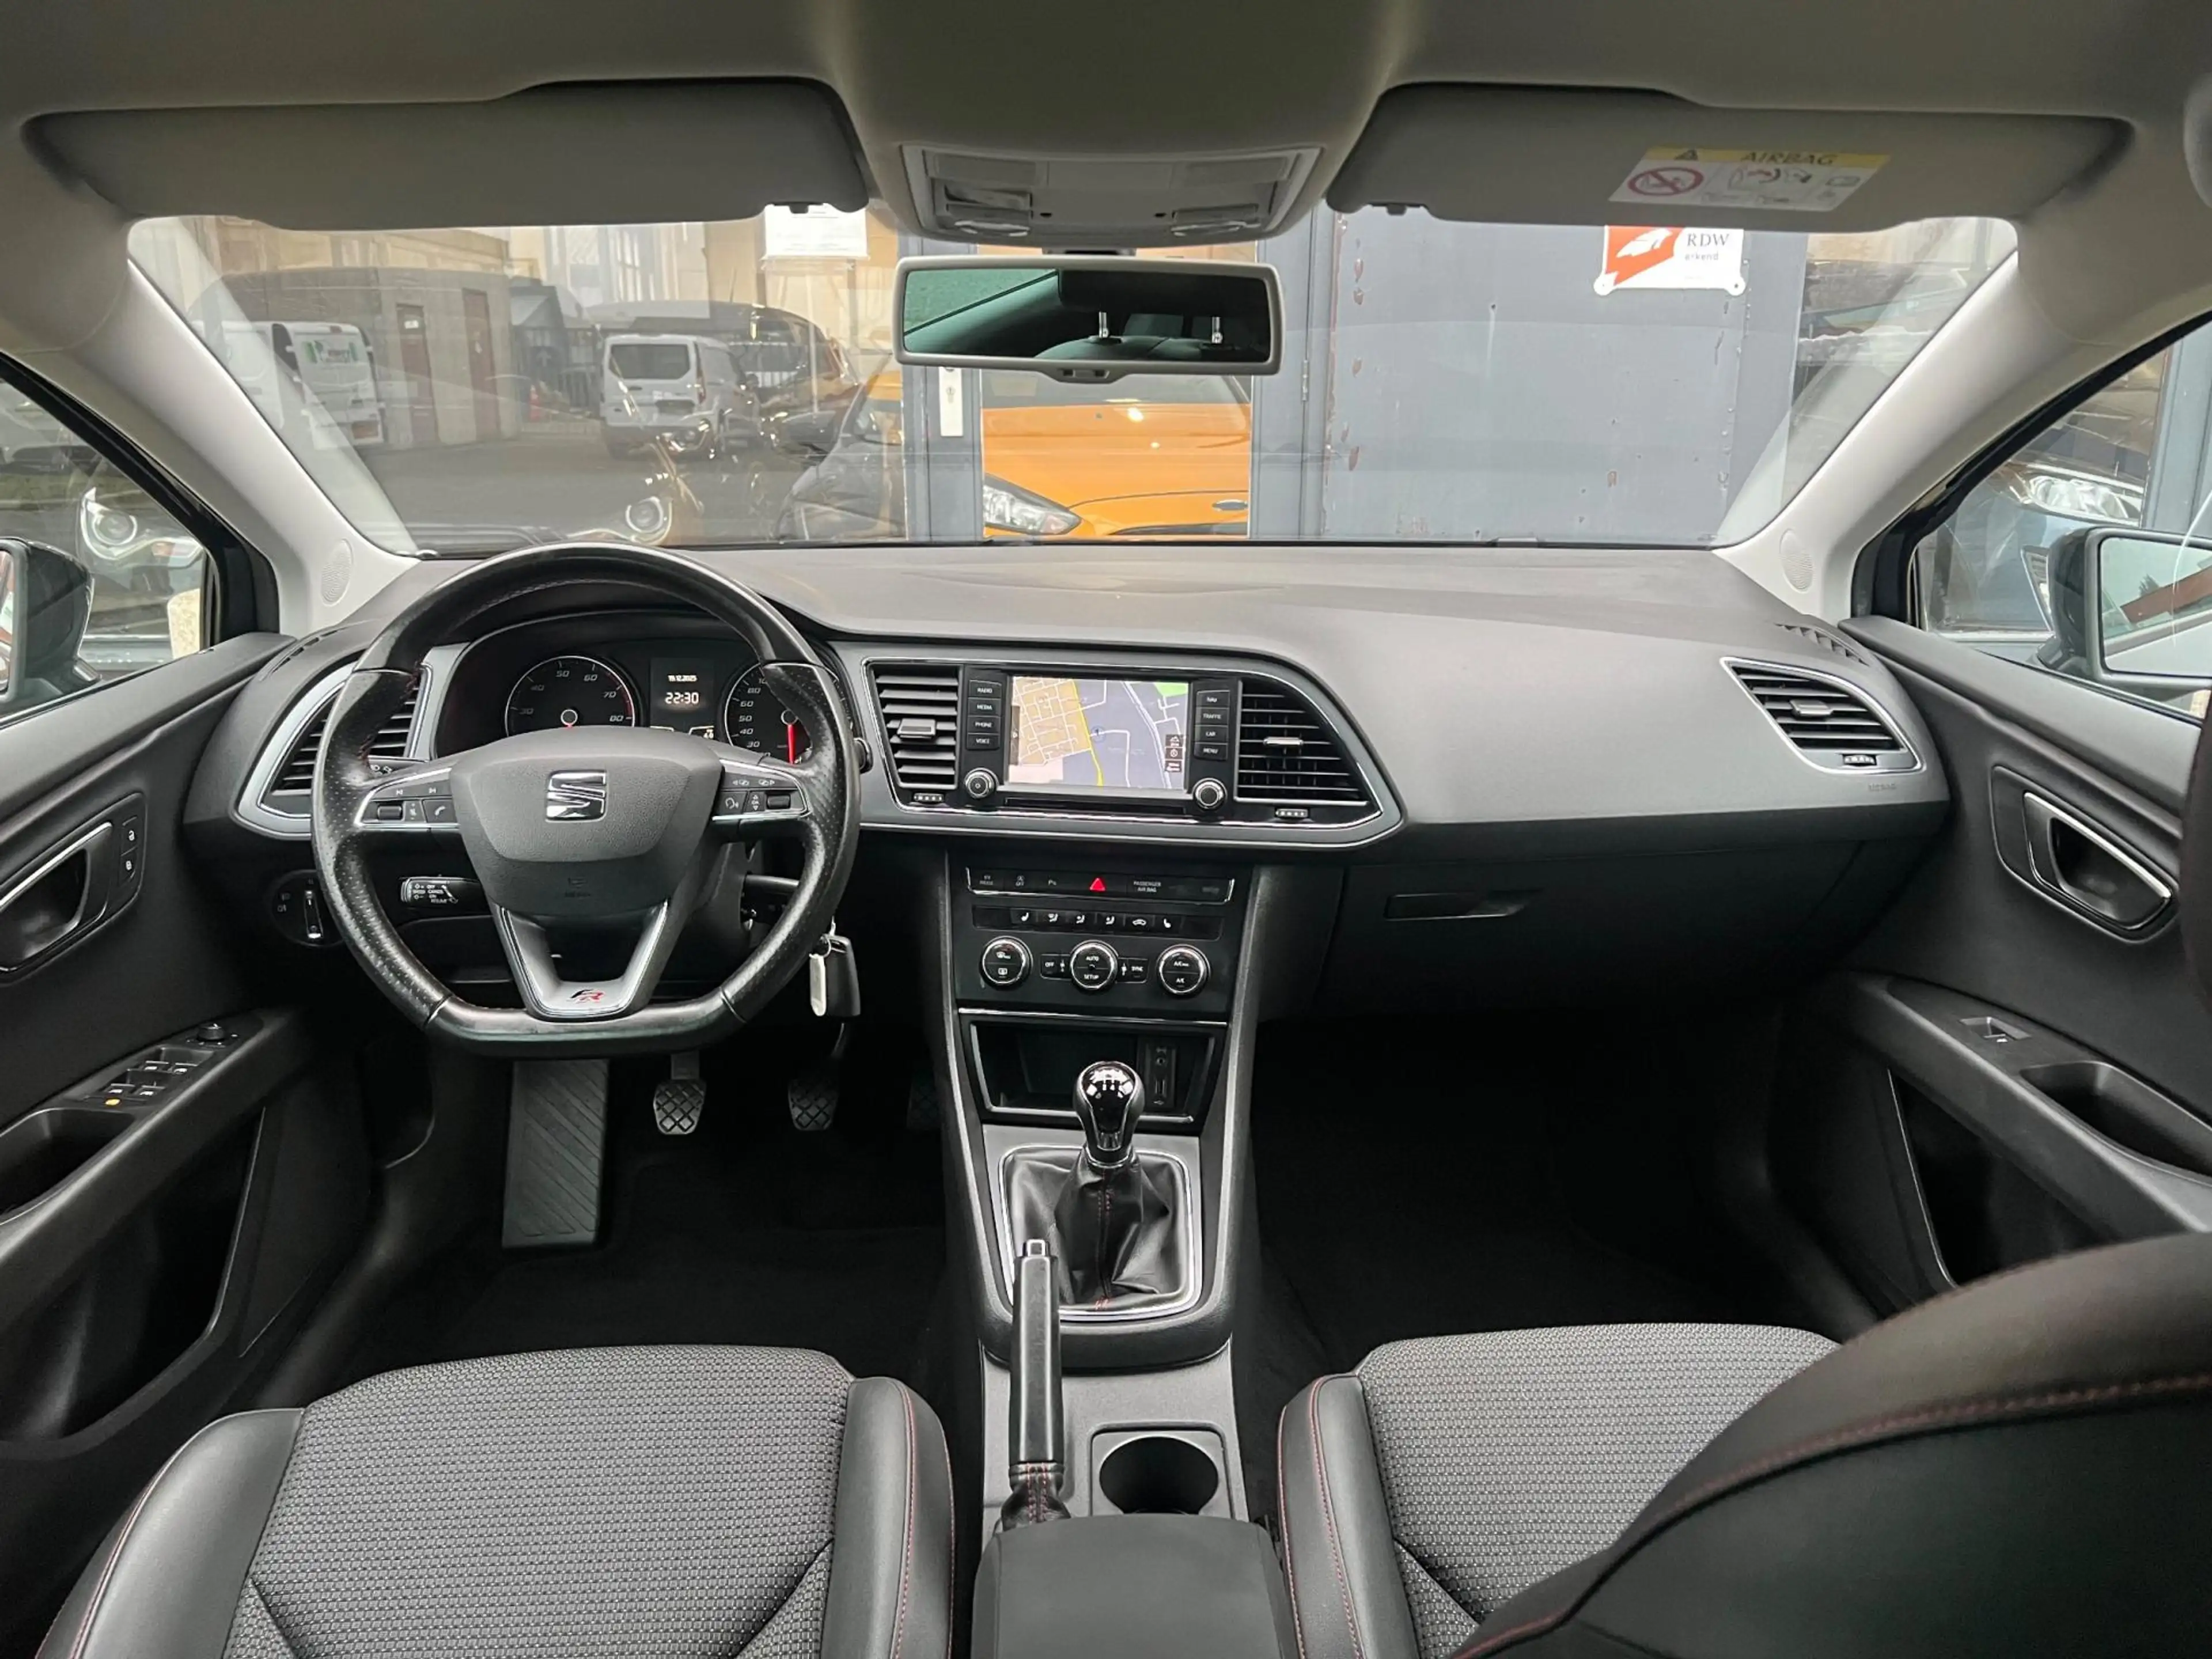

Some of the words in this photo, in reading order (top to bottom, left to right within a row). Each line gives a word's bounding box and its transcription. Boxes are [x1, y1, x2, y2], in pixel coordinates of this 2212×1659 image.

[1740, 151, 1839, 165] AIRBAG
[1687, 233, 1730, 247] RDW
[1685, 250, 1719, 262] erkend
[584, 674, 598, 682] 60
[603, 691, 617, 699] 70
[665, 692, 699, 704] 22:30
